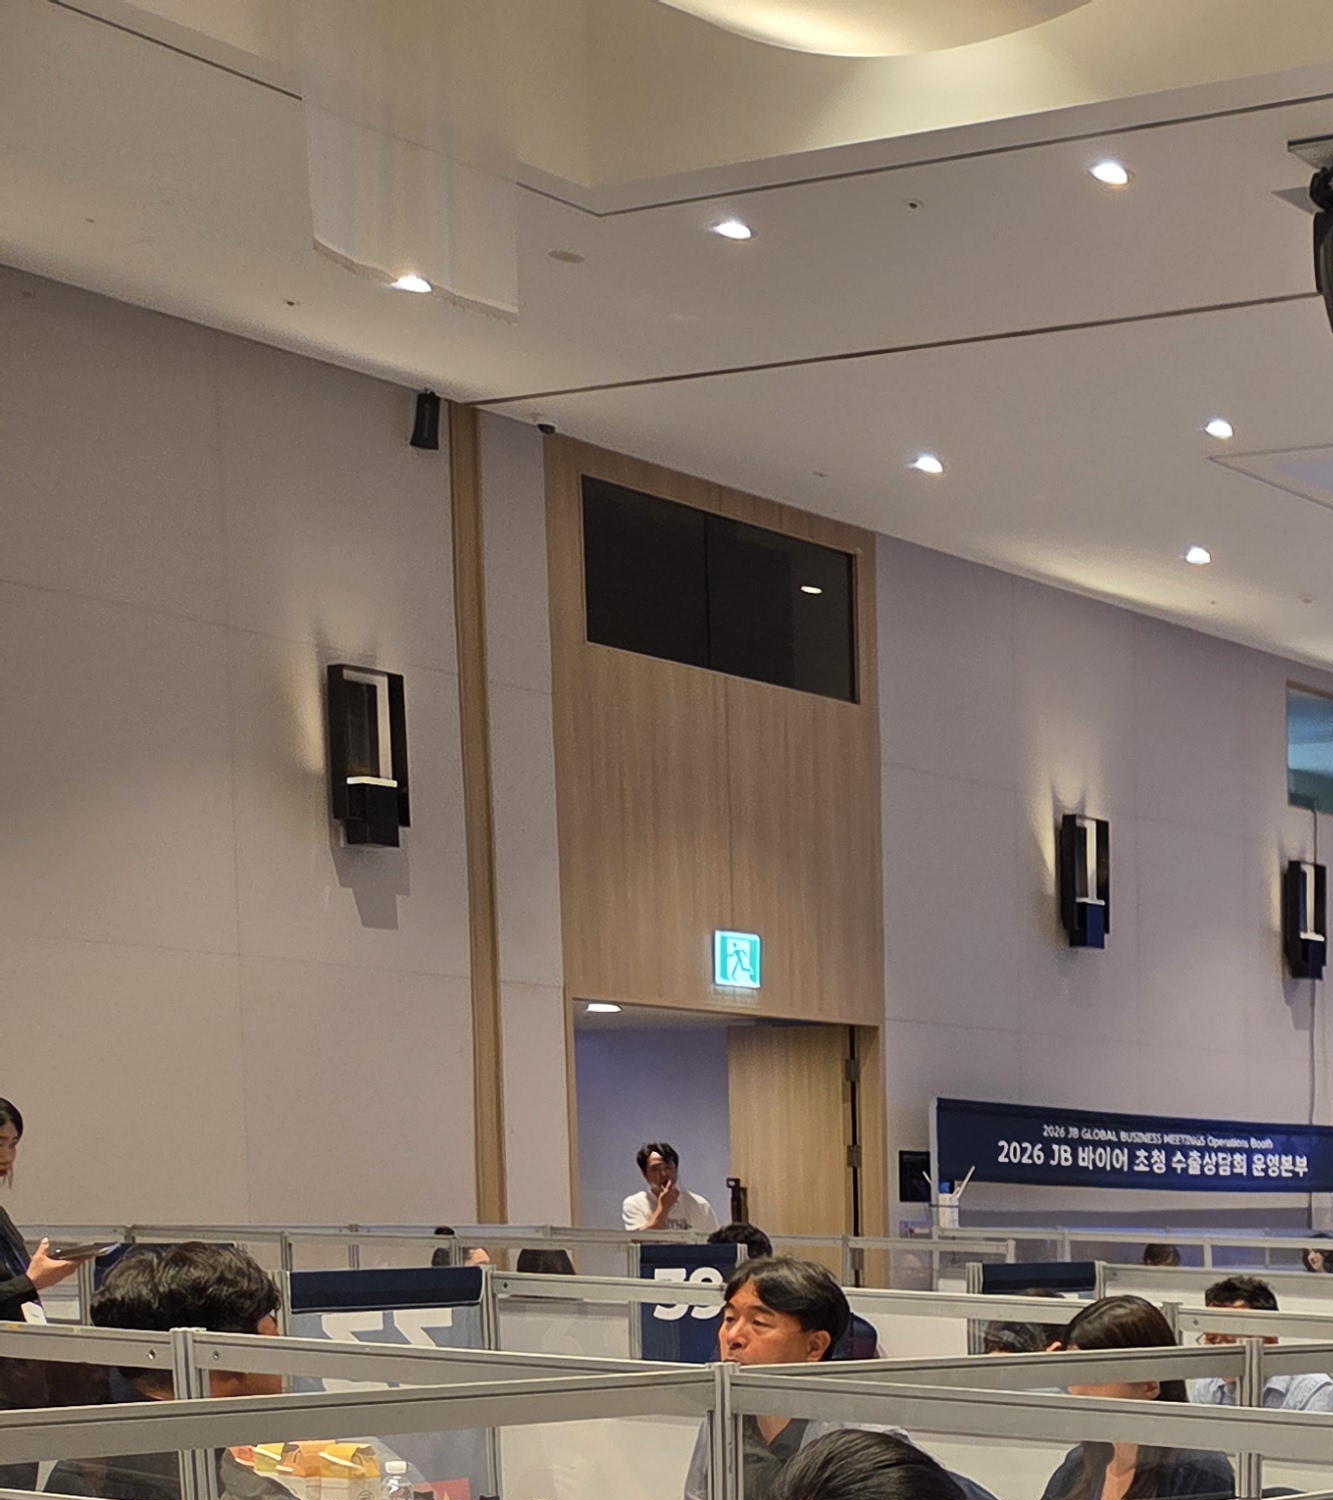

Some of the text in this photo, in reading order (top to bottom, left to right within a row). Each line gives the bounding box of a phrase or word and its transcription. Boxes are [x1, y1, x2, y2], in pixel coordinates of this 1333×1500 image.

[1042, 1124, 1066, 1139] 2026
[1067, 1126, 1079, 1140] JB
[1081, 1128, 1118, 1143] GLOBAL
[1120, 1130, 1162, 1145] BUSINESS
[1163, 1132, 1205, 1147] MEETINGS
[1206, 1136, 1249, 1150] Operations
[997, 1140, 1309, 1178] 2026 JB 바이어 초청 수출상담회 운영본부
